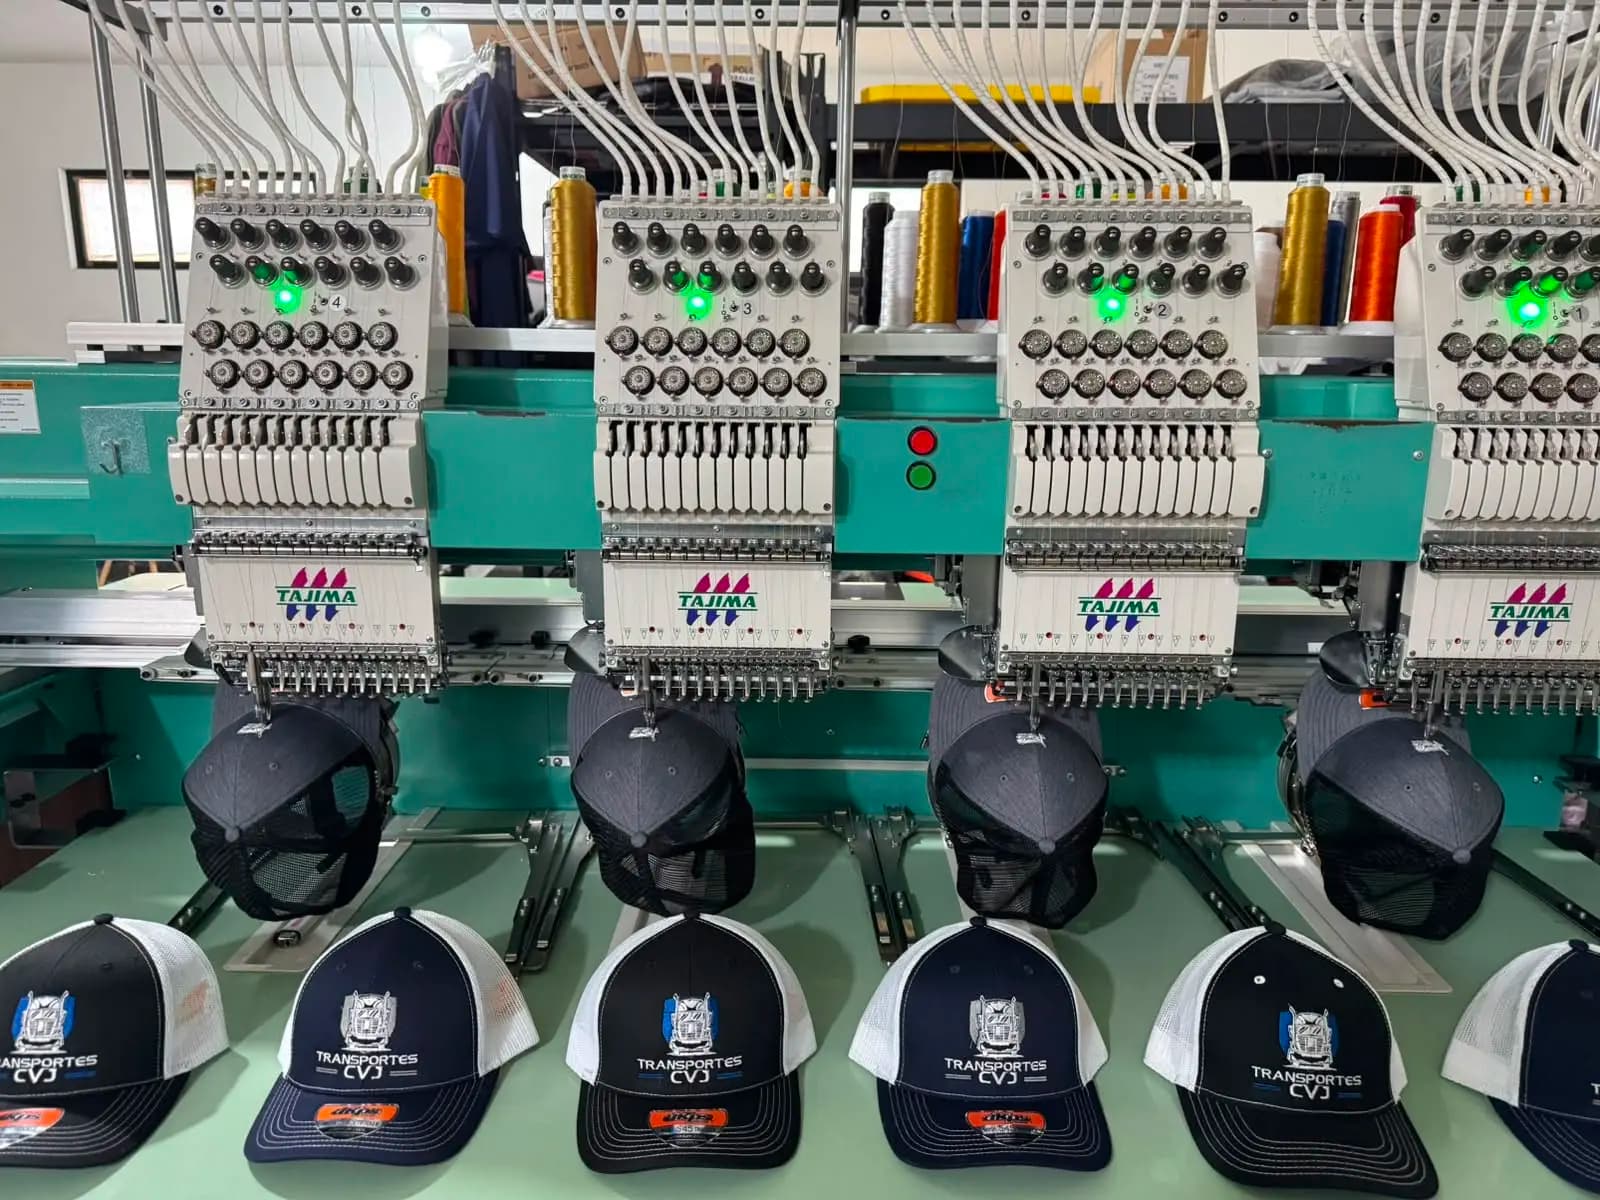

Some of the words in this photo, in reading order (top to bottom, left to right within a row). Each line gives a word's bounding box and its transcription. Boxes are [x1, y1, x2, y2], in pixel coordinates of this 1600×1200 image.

[332, 296, 341, 309] 4
[743, 302, 752, 315] 3
[1158, 304, 1167, 317] 2
[1575, 307, 1582, 320] 1
[276, 589, 356, 603] TAJIMA
[678, 595, 757, 608] TAJIMA
[1078, 600, 1159, 614] TAJIMA
[1490, 605, 1570, 619] TAJIMA
[0, 1054, 98, 1069] ANSPORTES
[316, 1050, 418, 1066] TRANSPORTES
[637, 1055, 742, 1070] TRANSPORTES
[944, 1057, 1047, 1072] TRANSPORTES
[13, 1068, 57, 1084] CVJ
[343, 1065, 383, 1080] CVJ
[670, 1069, 710, 1084] CVJ
[978, 1070, 1017, 1085] CVJ
[1251, 1065, 1362, 1086] TRANSPORTES
[1289, 1083, 1330, 1100] CVJ
